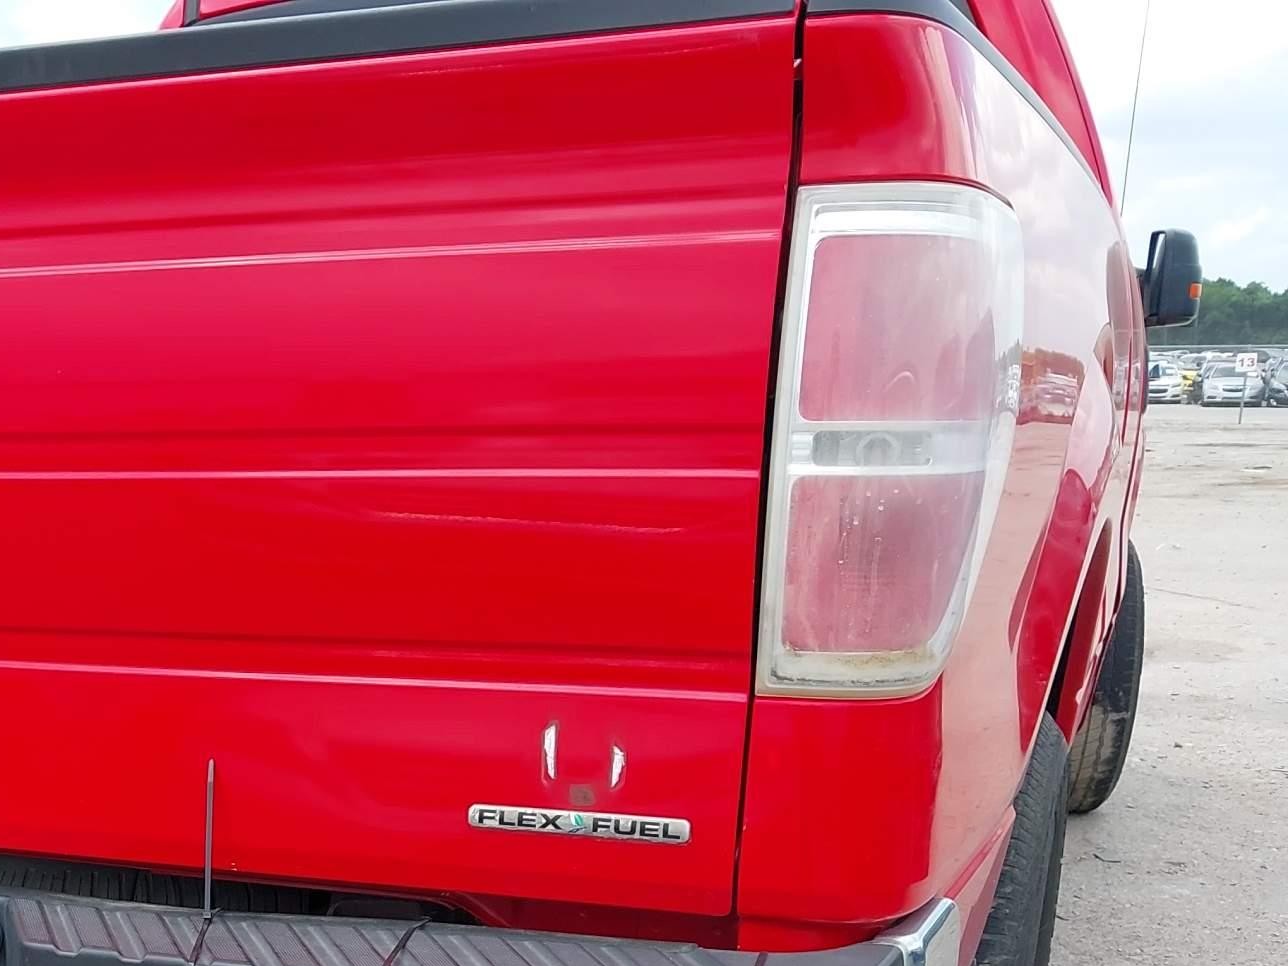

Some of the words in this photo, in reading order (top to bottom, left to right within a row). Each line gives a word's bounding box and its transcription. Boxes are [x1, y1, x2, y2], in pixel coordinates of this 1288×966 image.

[1238, 357, 1255, 368] 13
[478, 808, 563, 831] FLEX
[592, 817, 681, 840] FUEL
